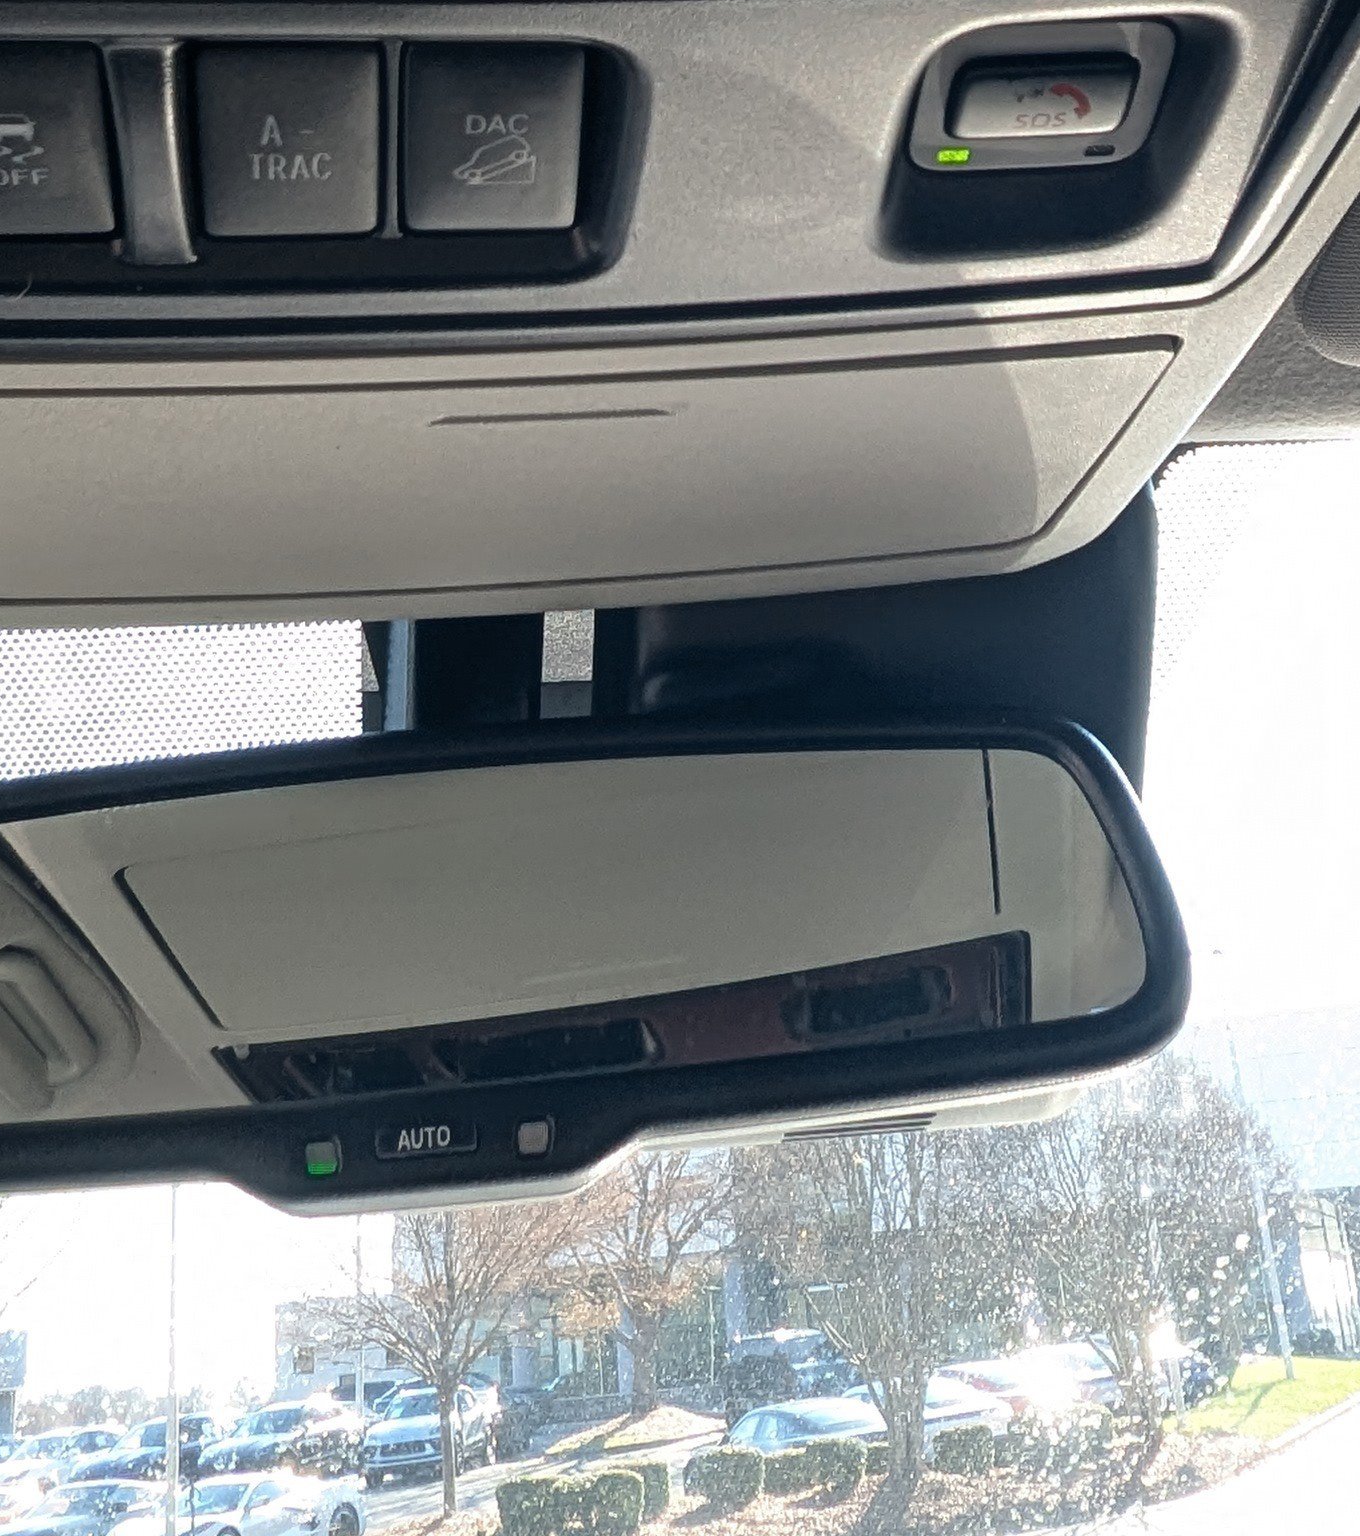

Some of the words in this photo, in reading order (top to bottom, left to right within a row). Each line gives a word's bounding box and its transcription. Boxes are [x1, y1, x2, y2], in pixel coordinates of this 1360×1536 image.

[465, 113, 530, 135] DAC
[1014, 112, 1067, 129] SOS
[249, 152, 333, 181] TRAC
[397, 1125, 451, 1151] AUTO
